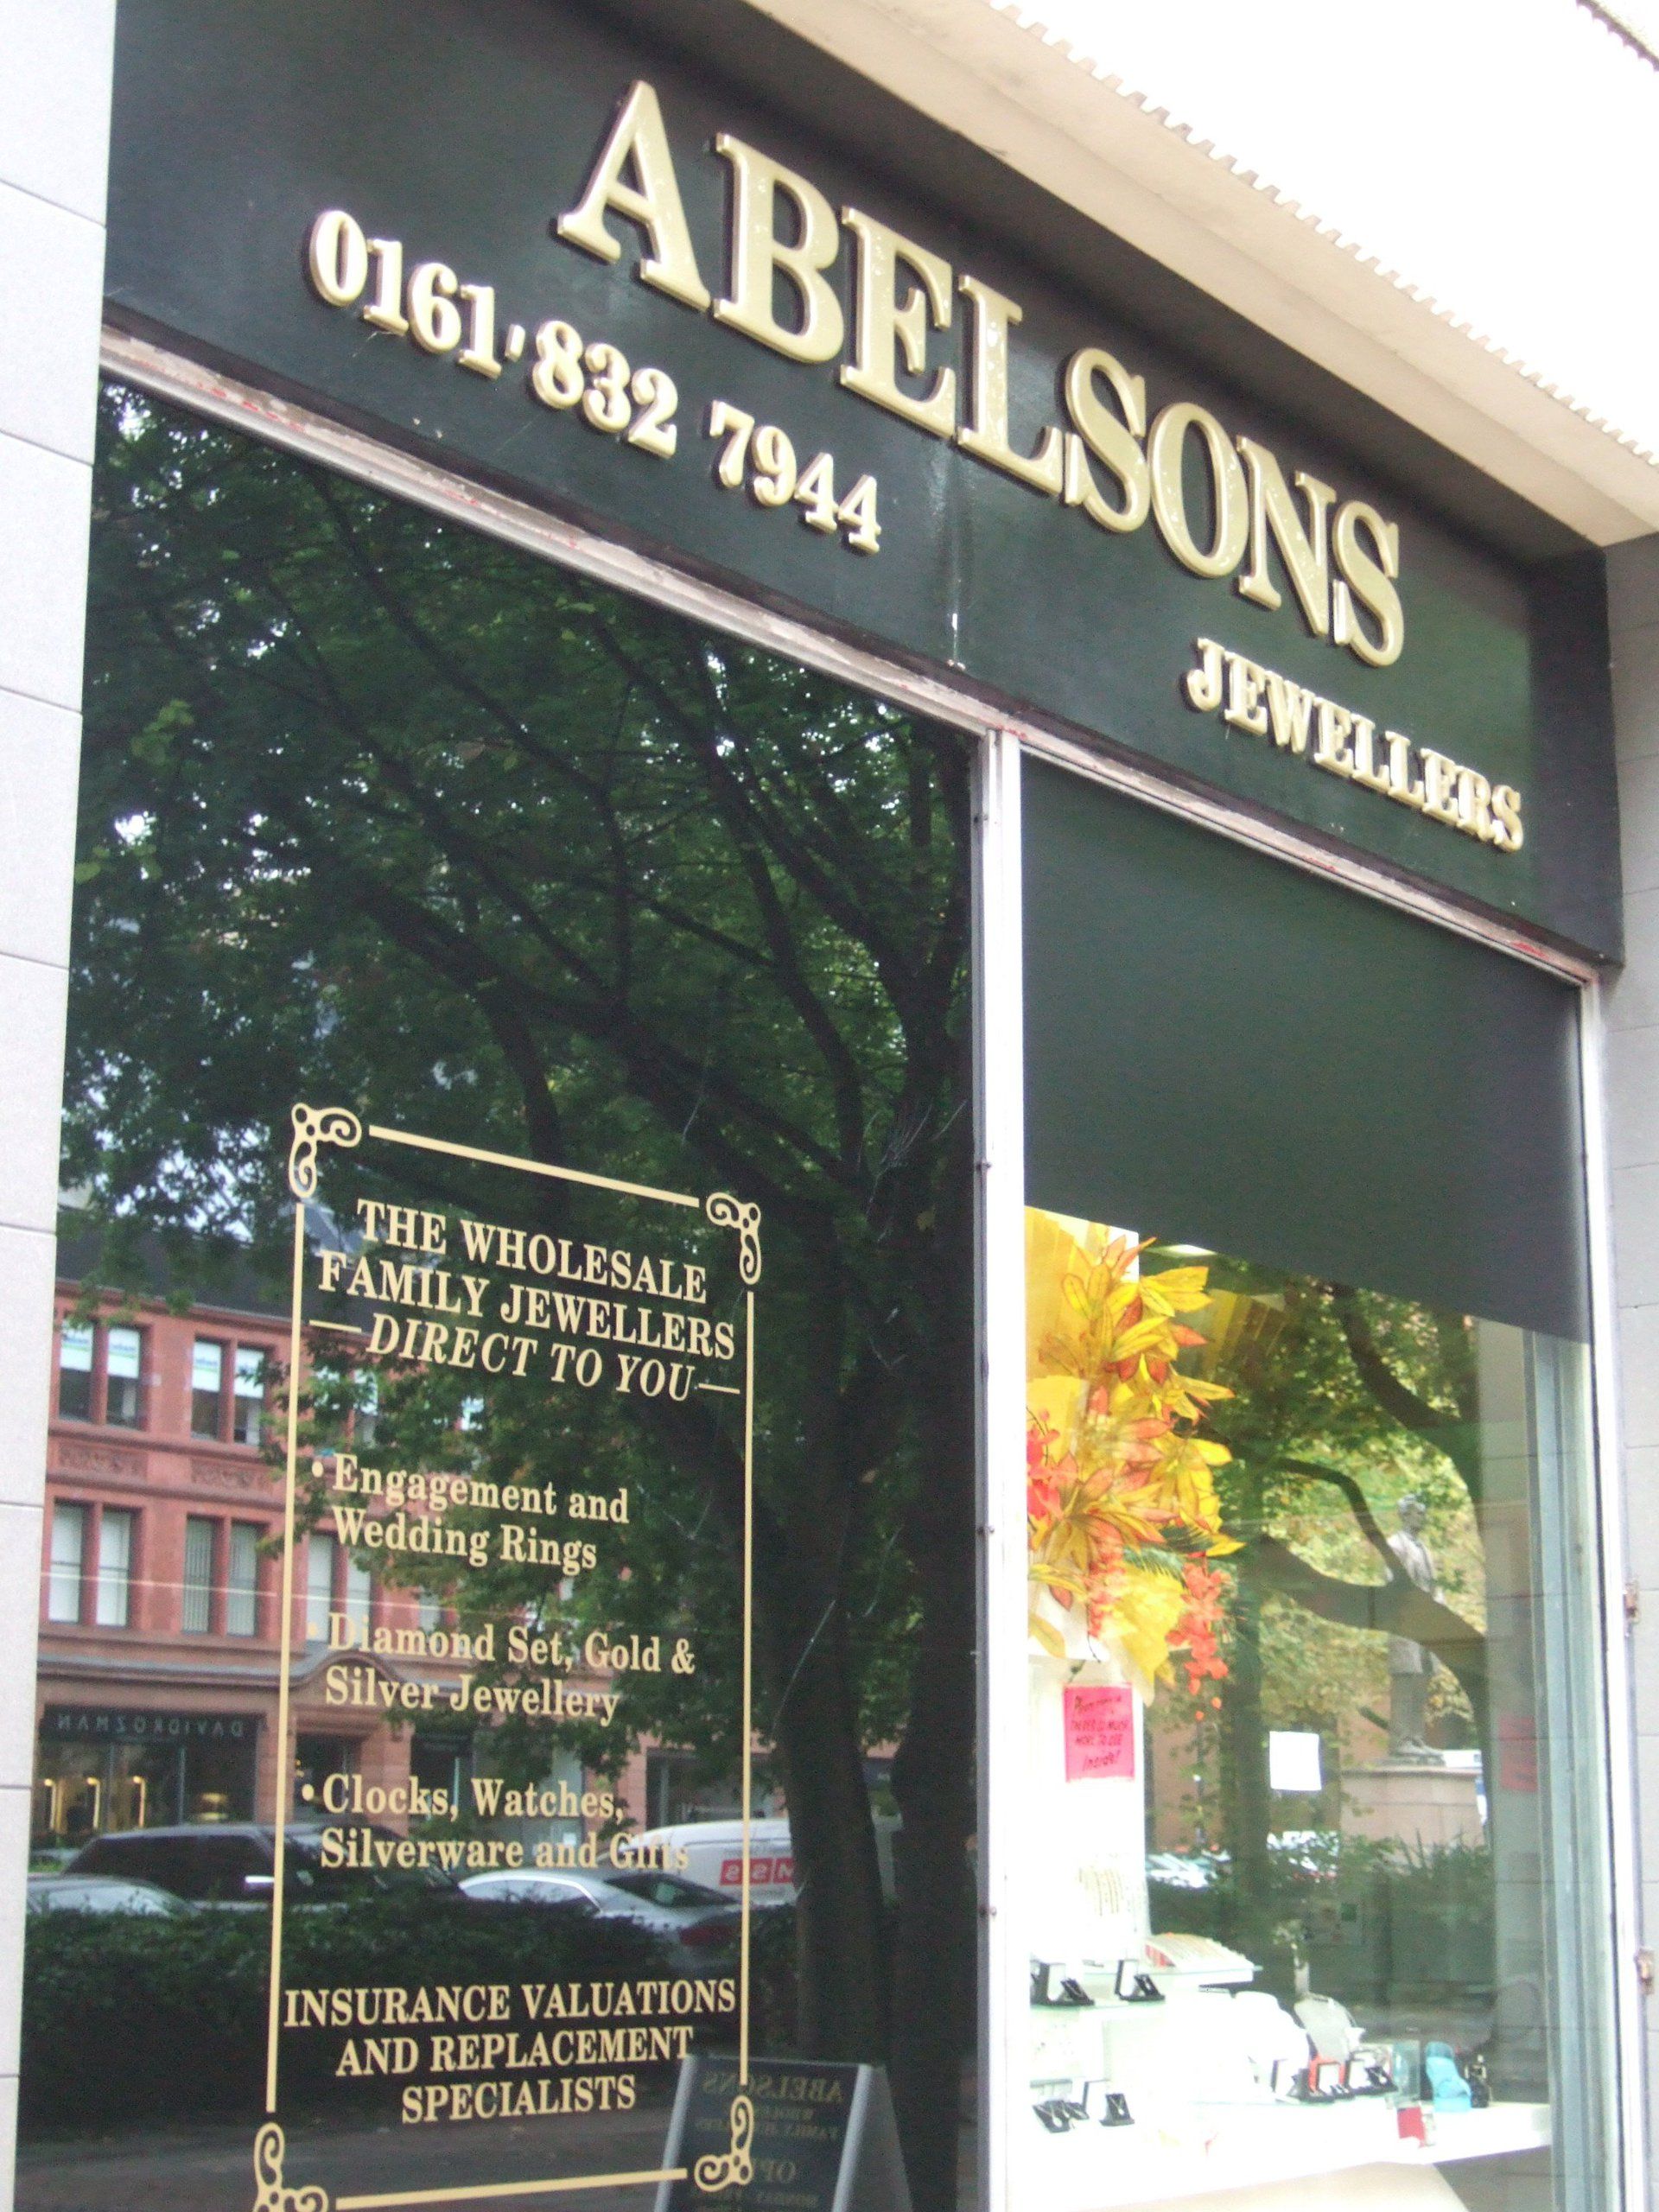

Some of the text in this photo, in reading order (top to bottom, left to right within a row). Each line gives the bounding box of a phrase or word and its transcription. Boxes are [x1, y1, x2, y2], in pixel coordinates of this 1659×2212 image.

[557, 79, 1405, 667] ABELSONS
[709, 398, 882, 554] 7944
[1185, 637, 1524, 853] JEWELLERS
[357, 1198, 707, 1304] THE WHOLESALE
[318, 1249, 735, 1361] FAMILY JEWELLERS
[366, 1313, 696, 1402] DIRECT TO YOU
[334, 1452, 630, 1524] Engagement and
[334, 1506, 597, 1576] Wedding Rings
[328, 1612, 696, 1674] Diamond Set, Gold &
[325, 1665, 621, 1727] Silver Jewellery
[322, 1773, 626, 1823] Clocks, Watches,
[321, 1827, 691, 1872] Silverware and Gifts
[283, 1979, 736, 2027] INSURANCE VALUATIONS
[335, 2026, 694, 2077] AND REPLACEMENT
[401, 2075, 636, 2124] SPECIALISTS
